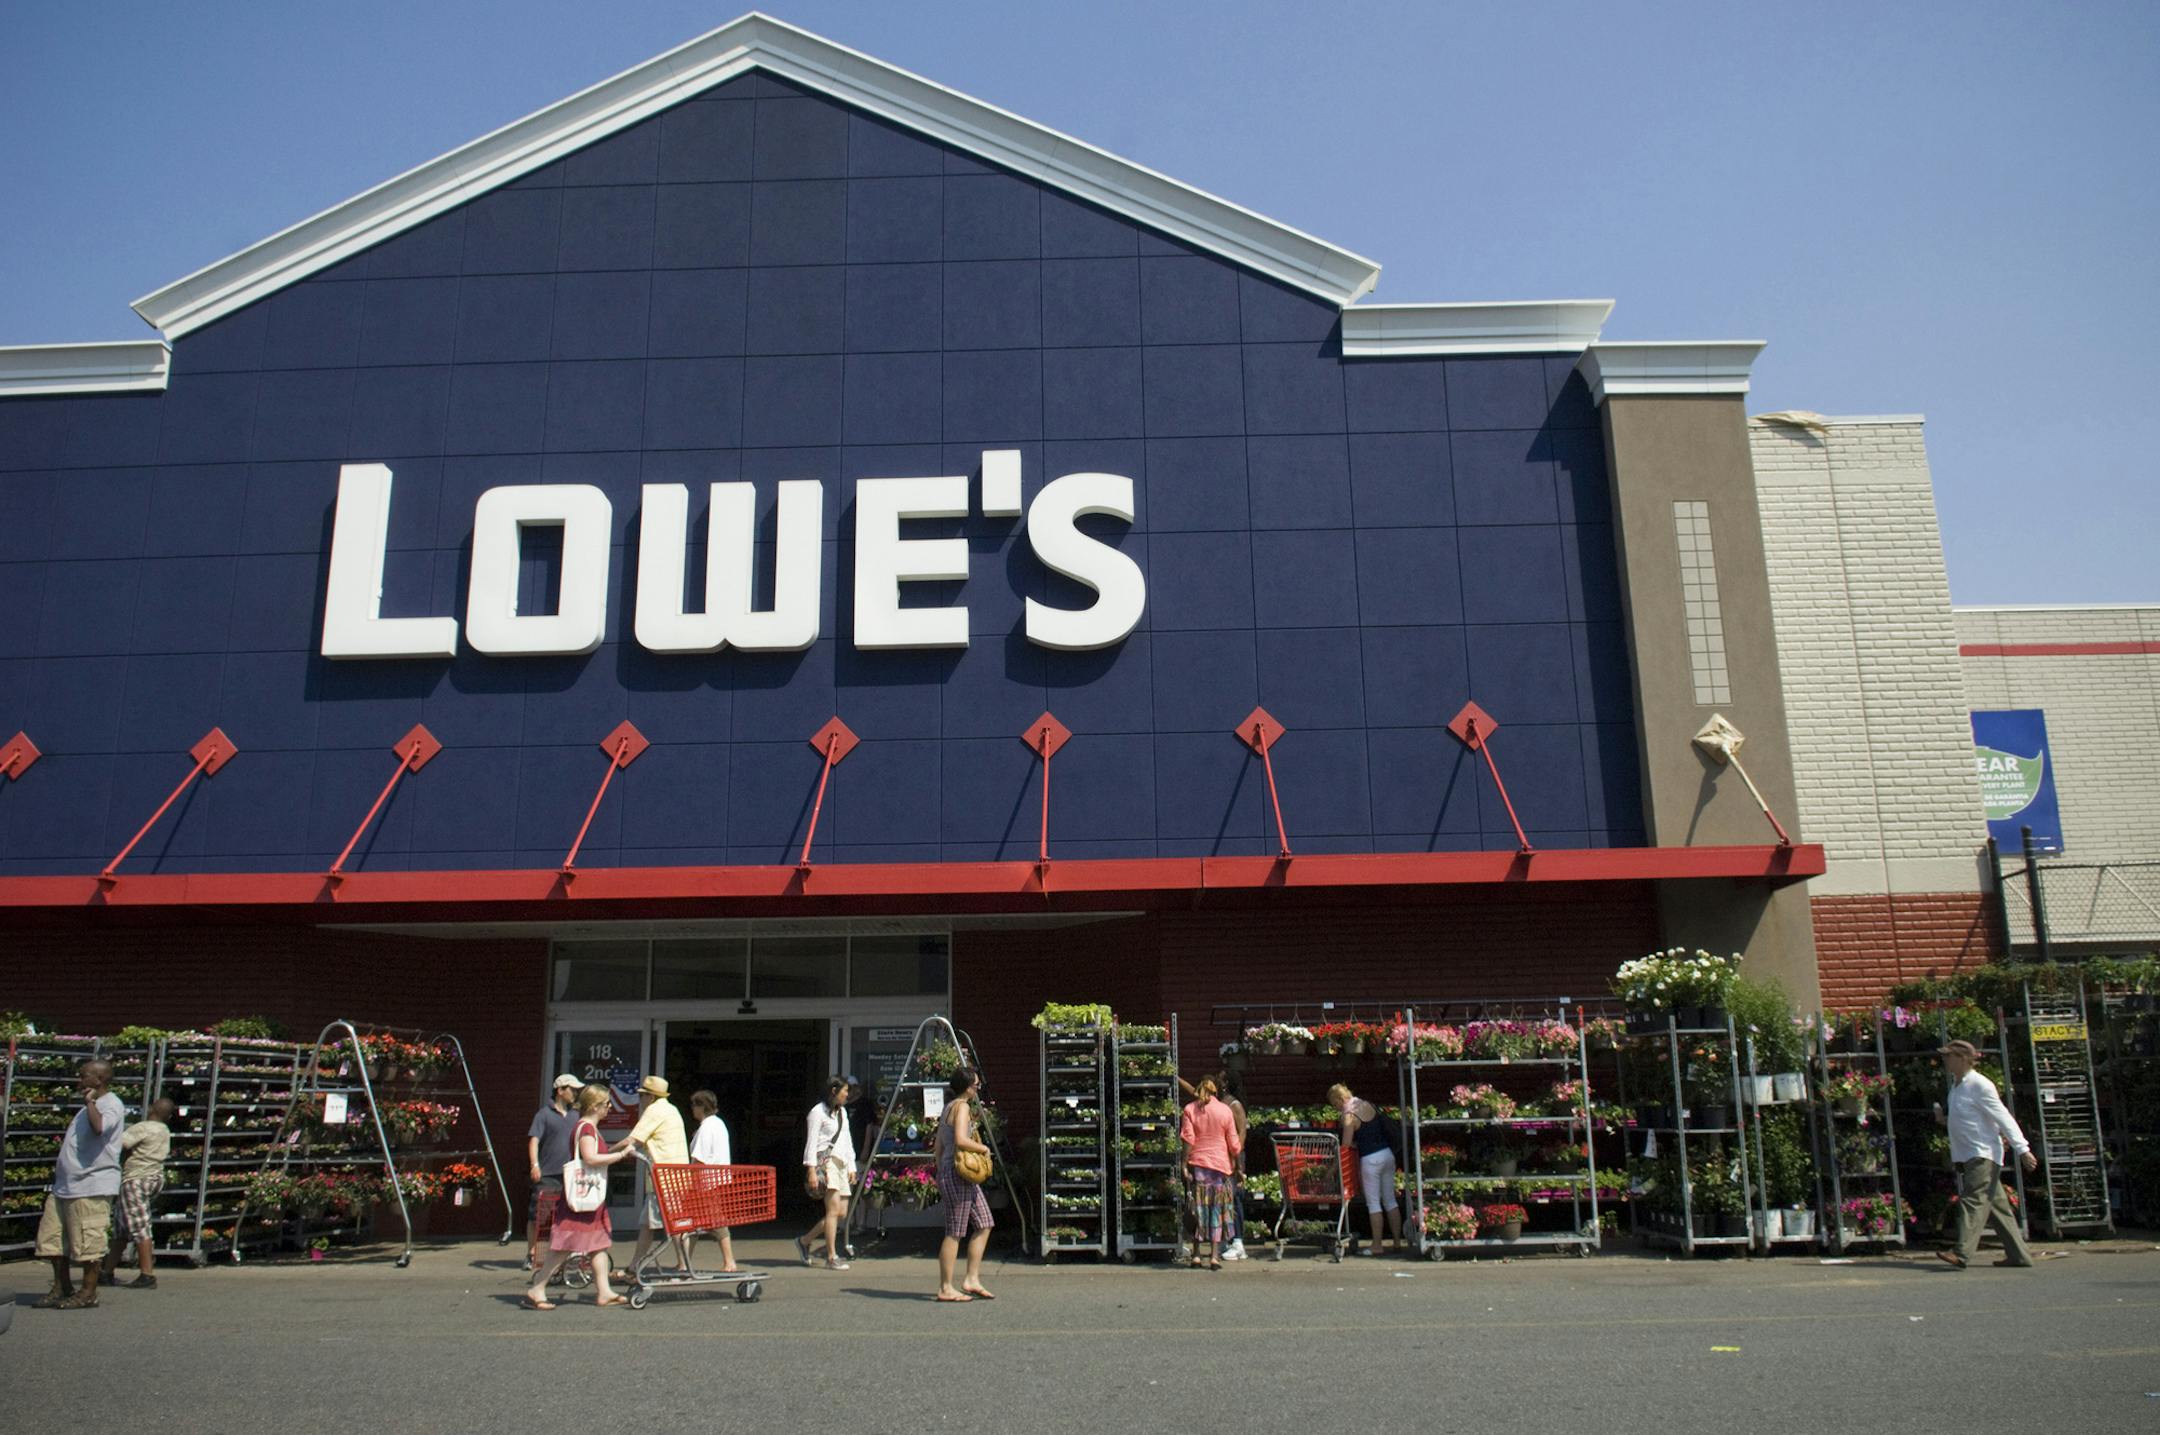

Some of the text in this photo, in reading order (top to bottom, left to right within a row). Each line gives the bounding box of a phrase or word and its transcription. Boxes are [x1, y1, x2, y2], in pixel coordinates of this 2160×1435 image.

[321, 449, 1146, 657] LOWE'S
[1977, 757, 2020, 772] EAR
[1979, 773, 2024, 781] ARANTEE
[589, 1044, 612, 1060] 118
